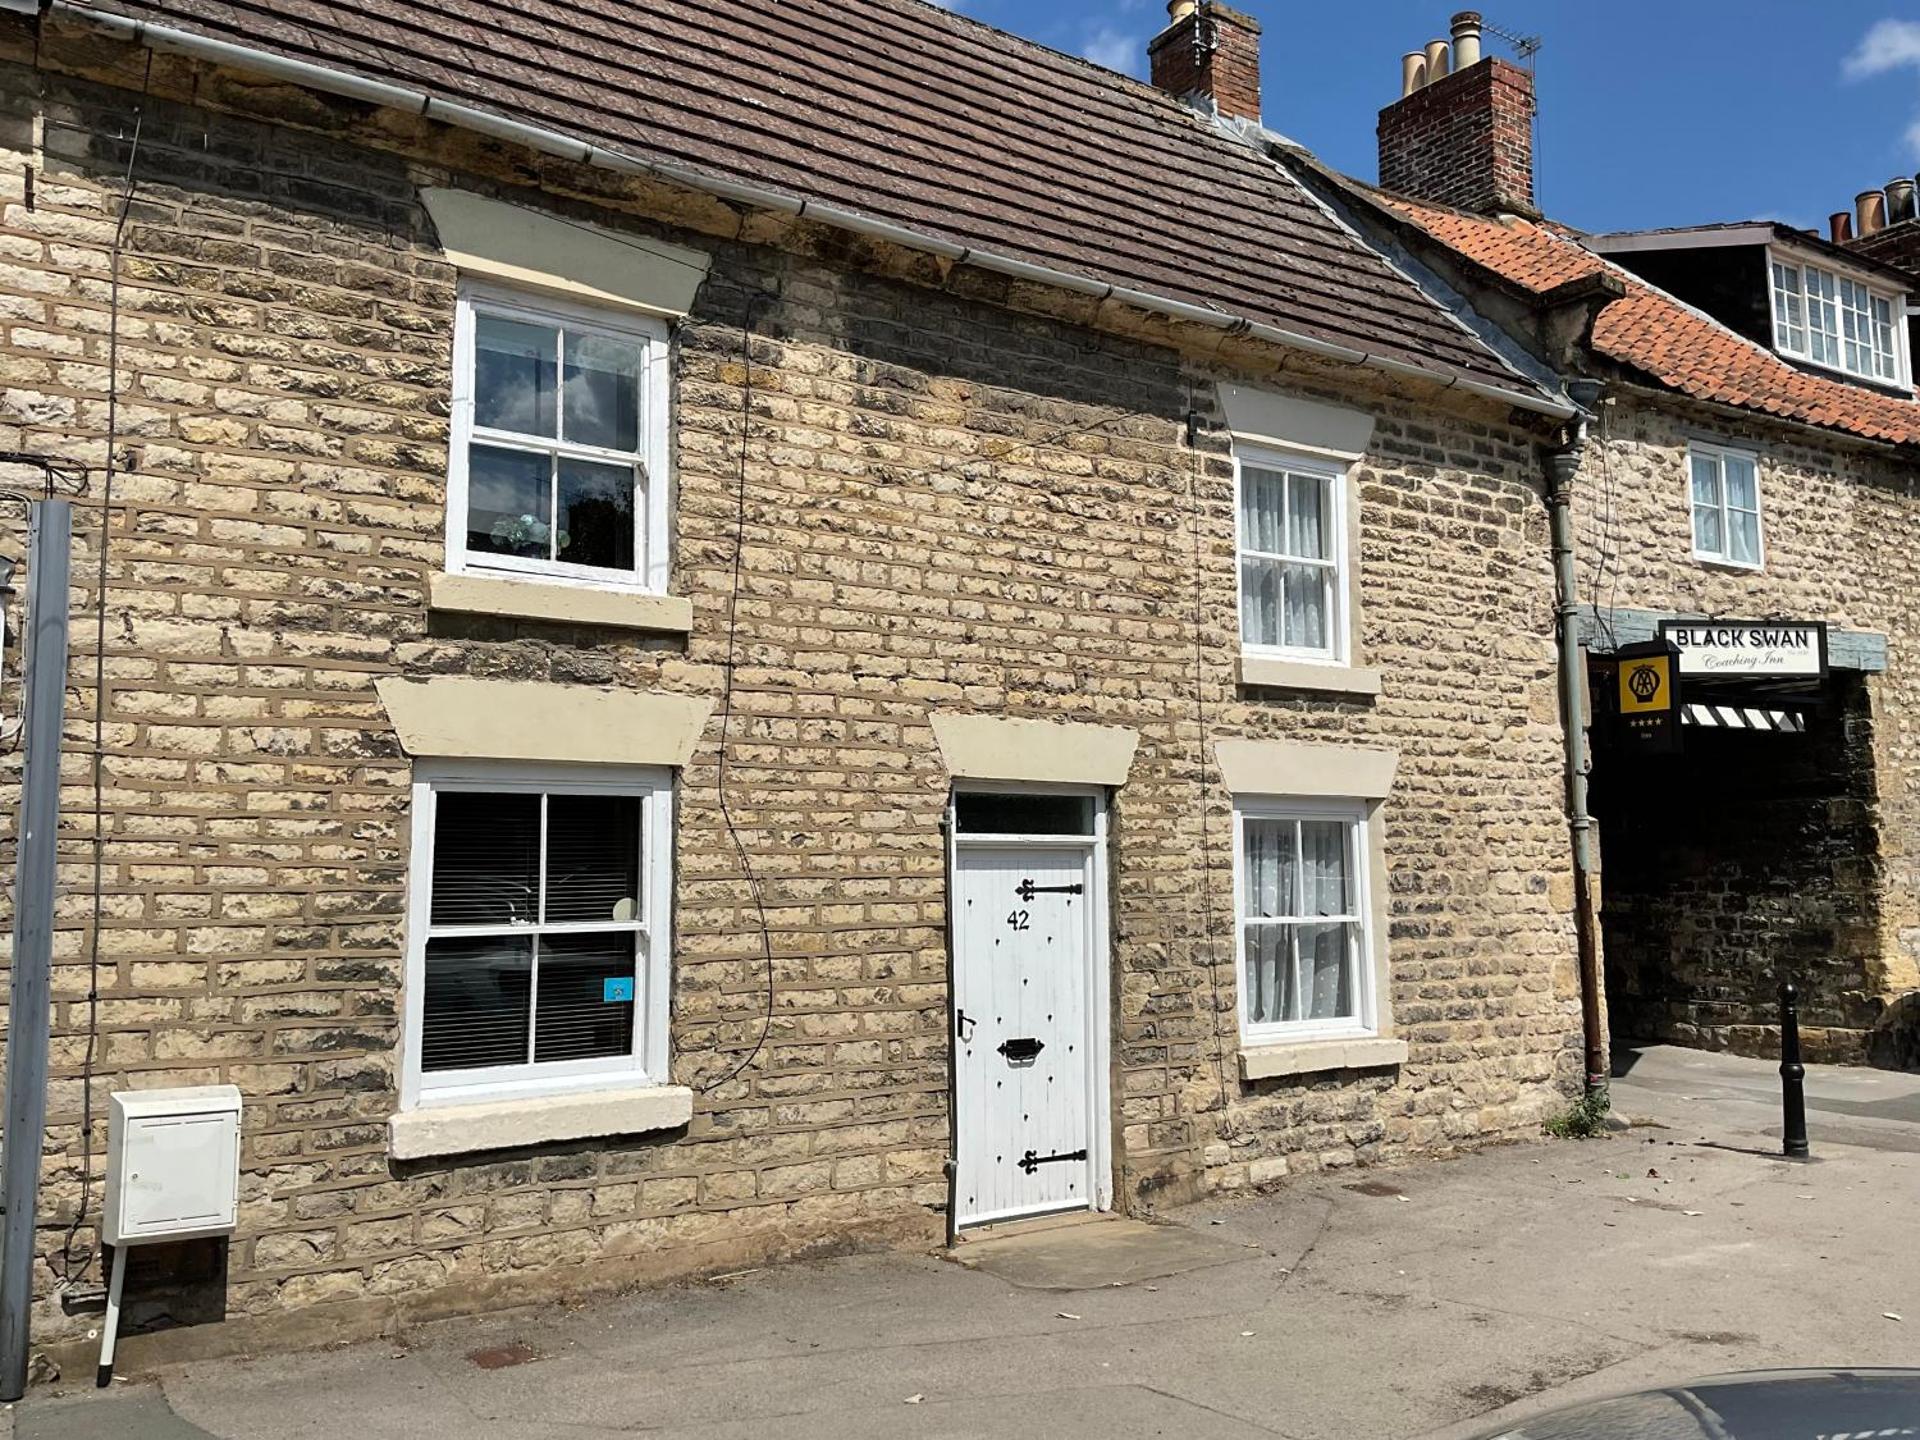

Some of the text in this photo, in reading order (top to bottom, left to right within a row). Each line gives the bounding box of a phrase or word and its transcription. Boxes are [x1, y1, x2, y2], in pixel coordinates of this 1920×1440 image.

[1676, 629, 1808, 648] BLACK SWAN
[1702, 653, 1757, 669] Coaching
[1759, 650, 1784, 664] Inn
[1007, 909, 1030, 931] 42
